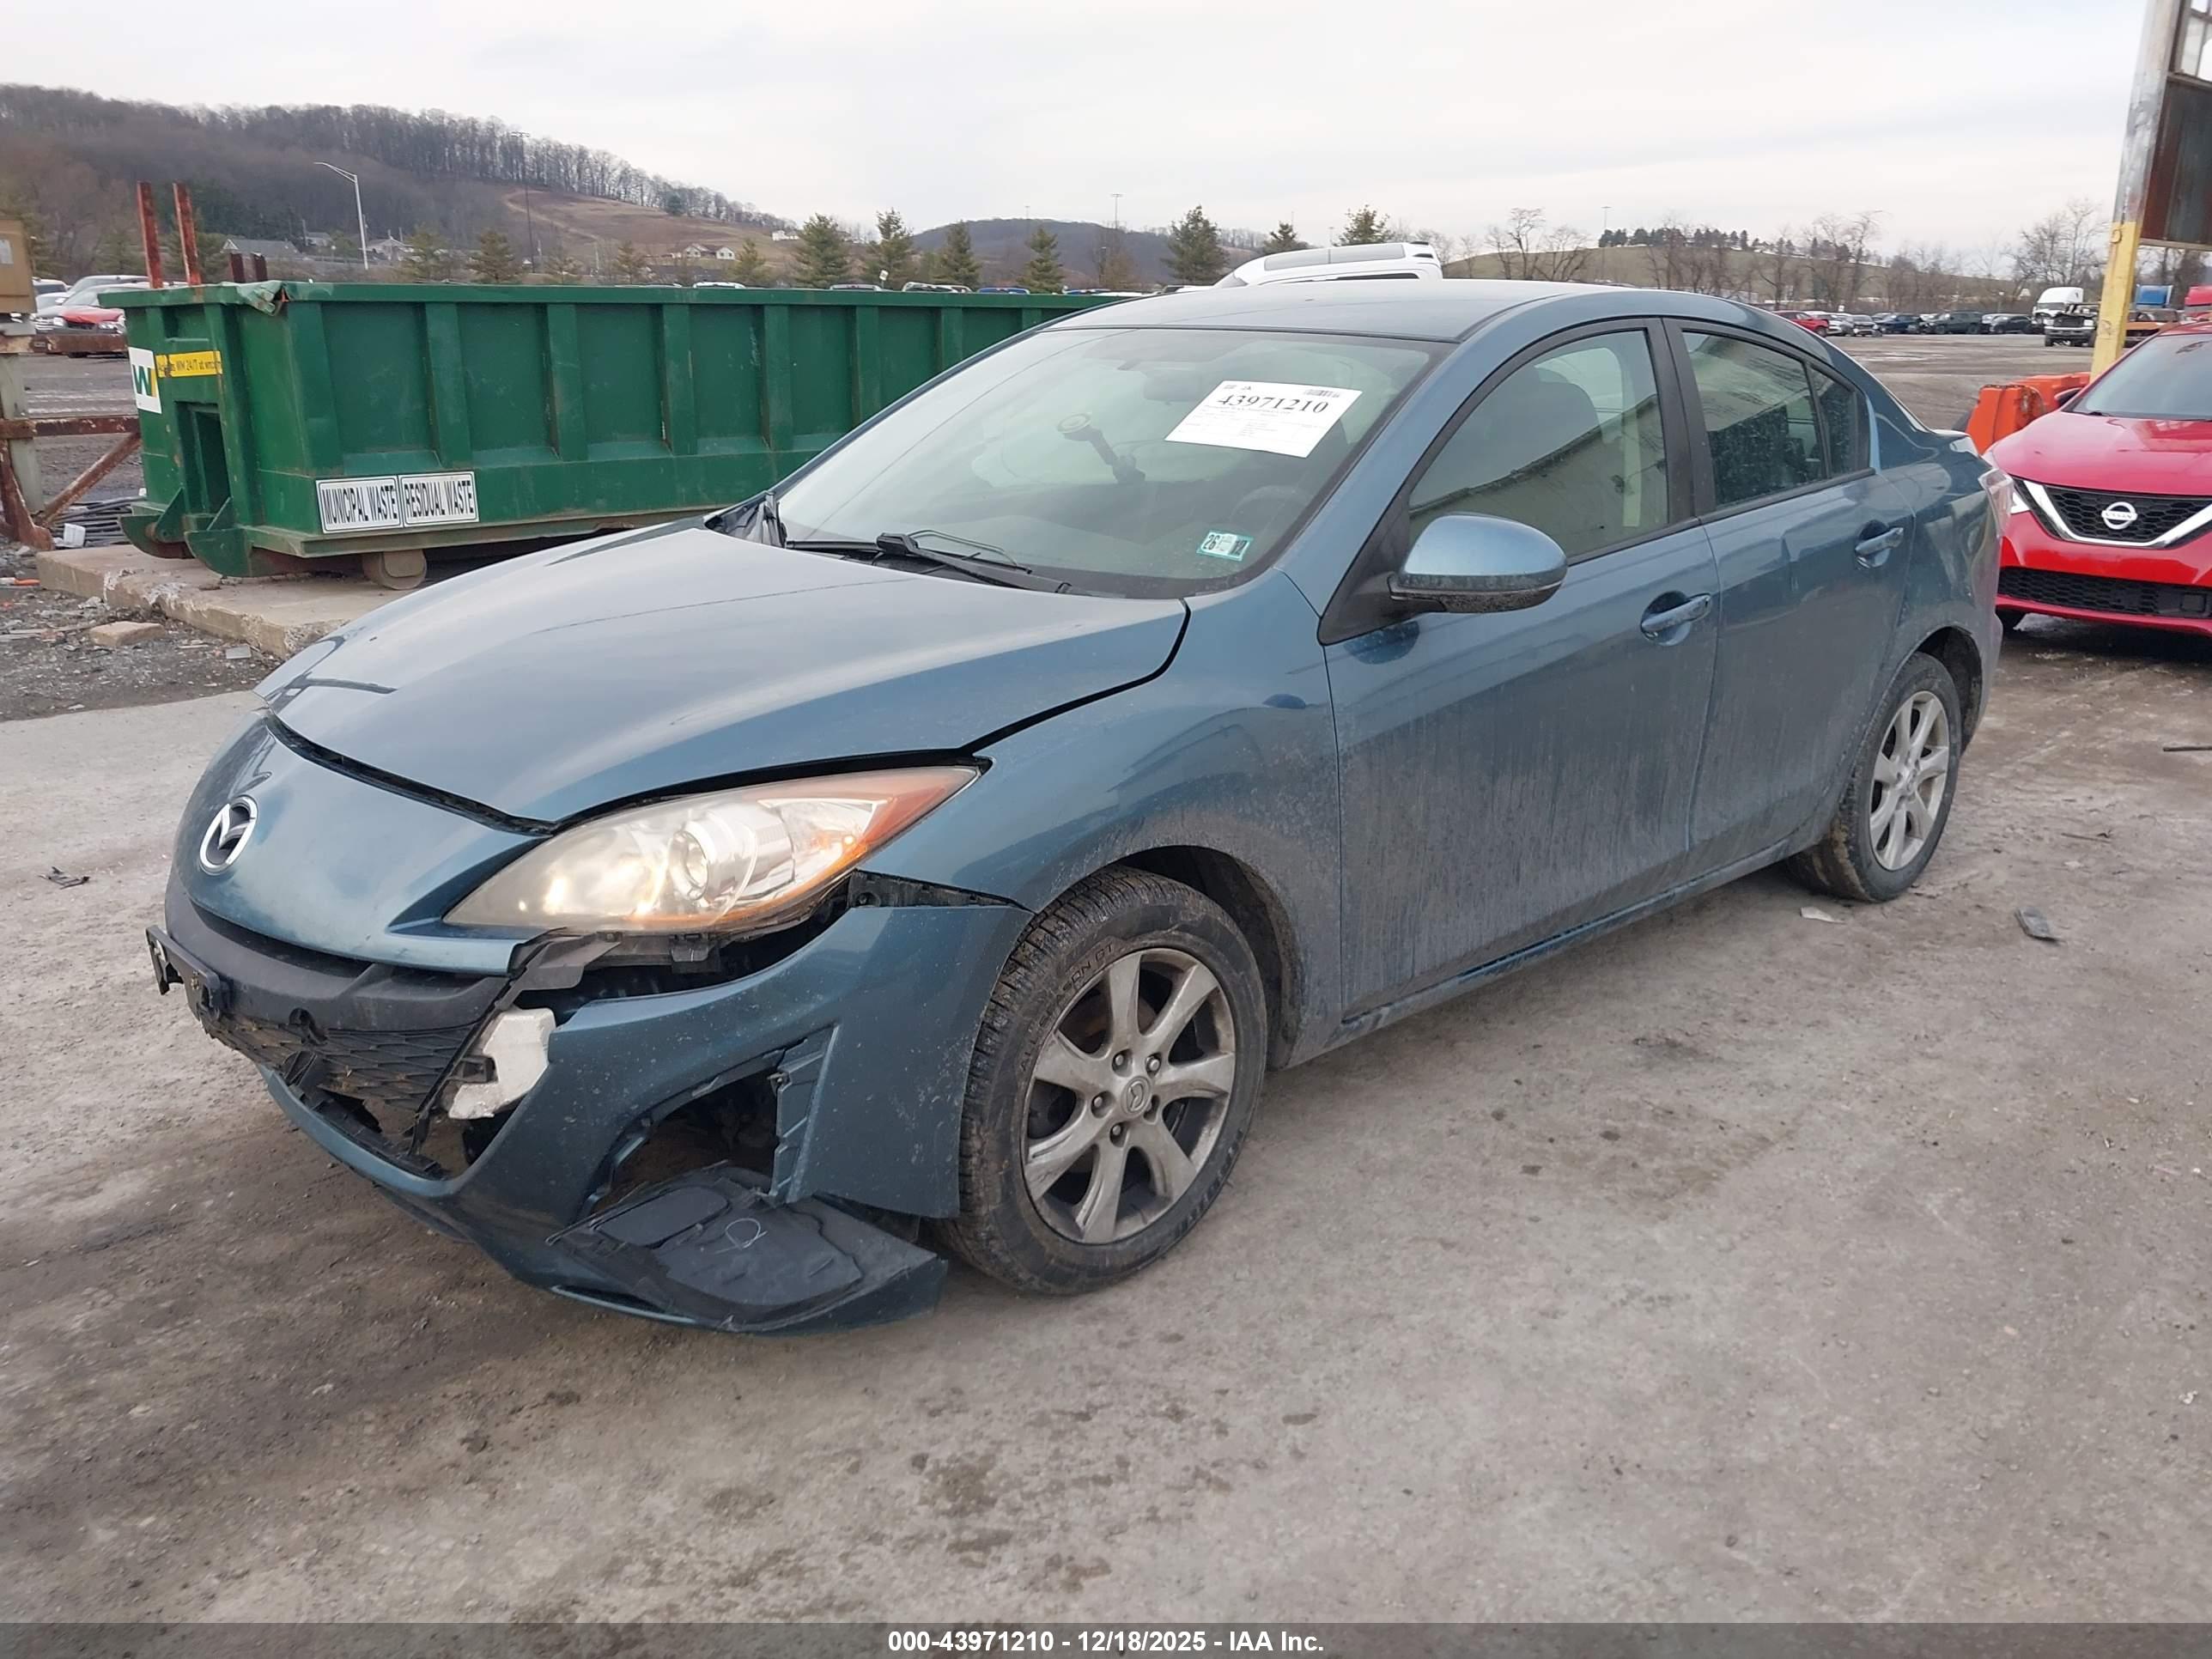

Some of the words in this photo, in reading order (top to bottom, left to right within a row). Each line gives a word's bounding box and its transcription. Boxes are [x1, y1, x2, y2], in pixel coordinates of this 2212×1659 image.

[1217, 394, 1329, 413] 43971210
[322, 487, 368, 525] MUNICIPAL
[367, 485, 398, 520] WASTE
[404, 482, 445, 518] RESIDUAL
[444, 480, 474, 515] WASTE
[1203, 534, 1220, 550] 26
